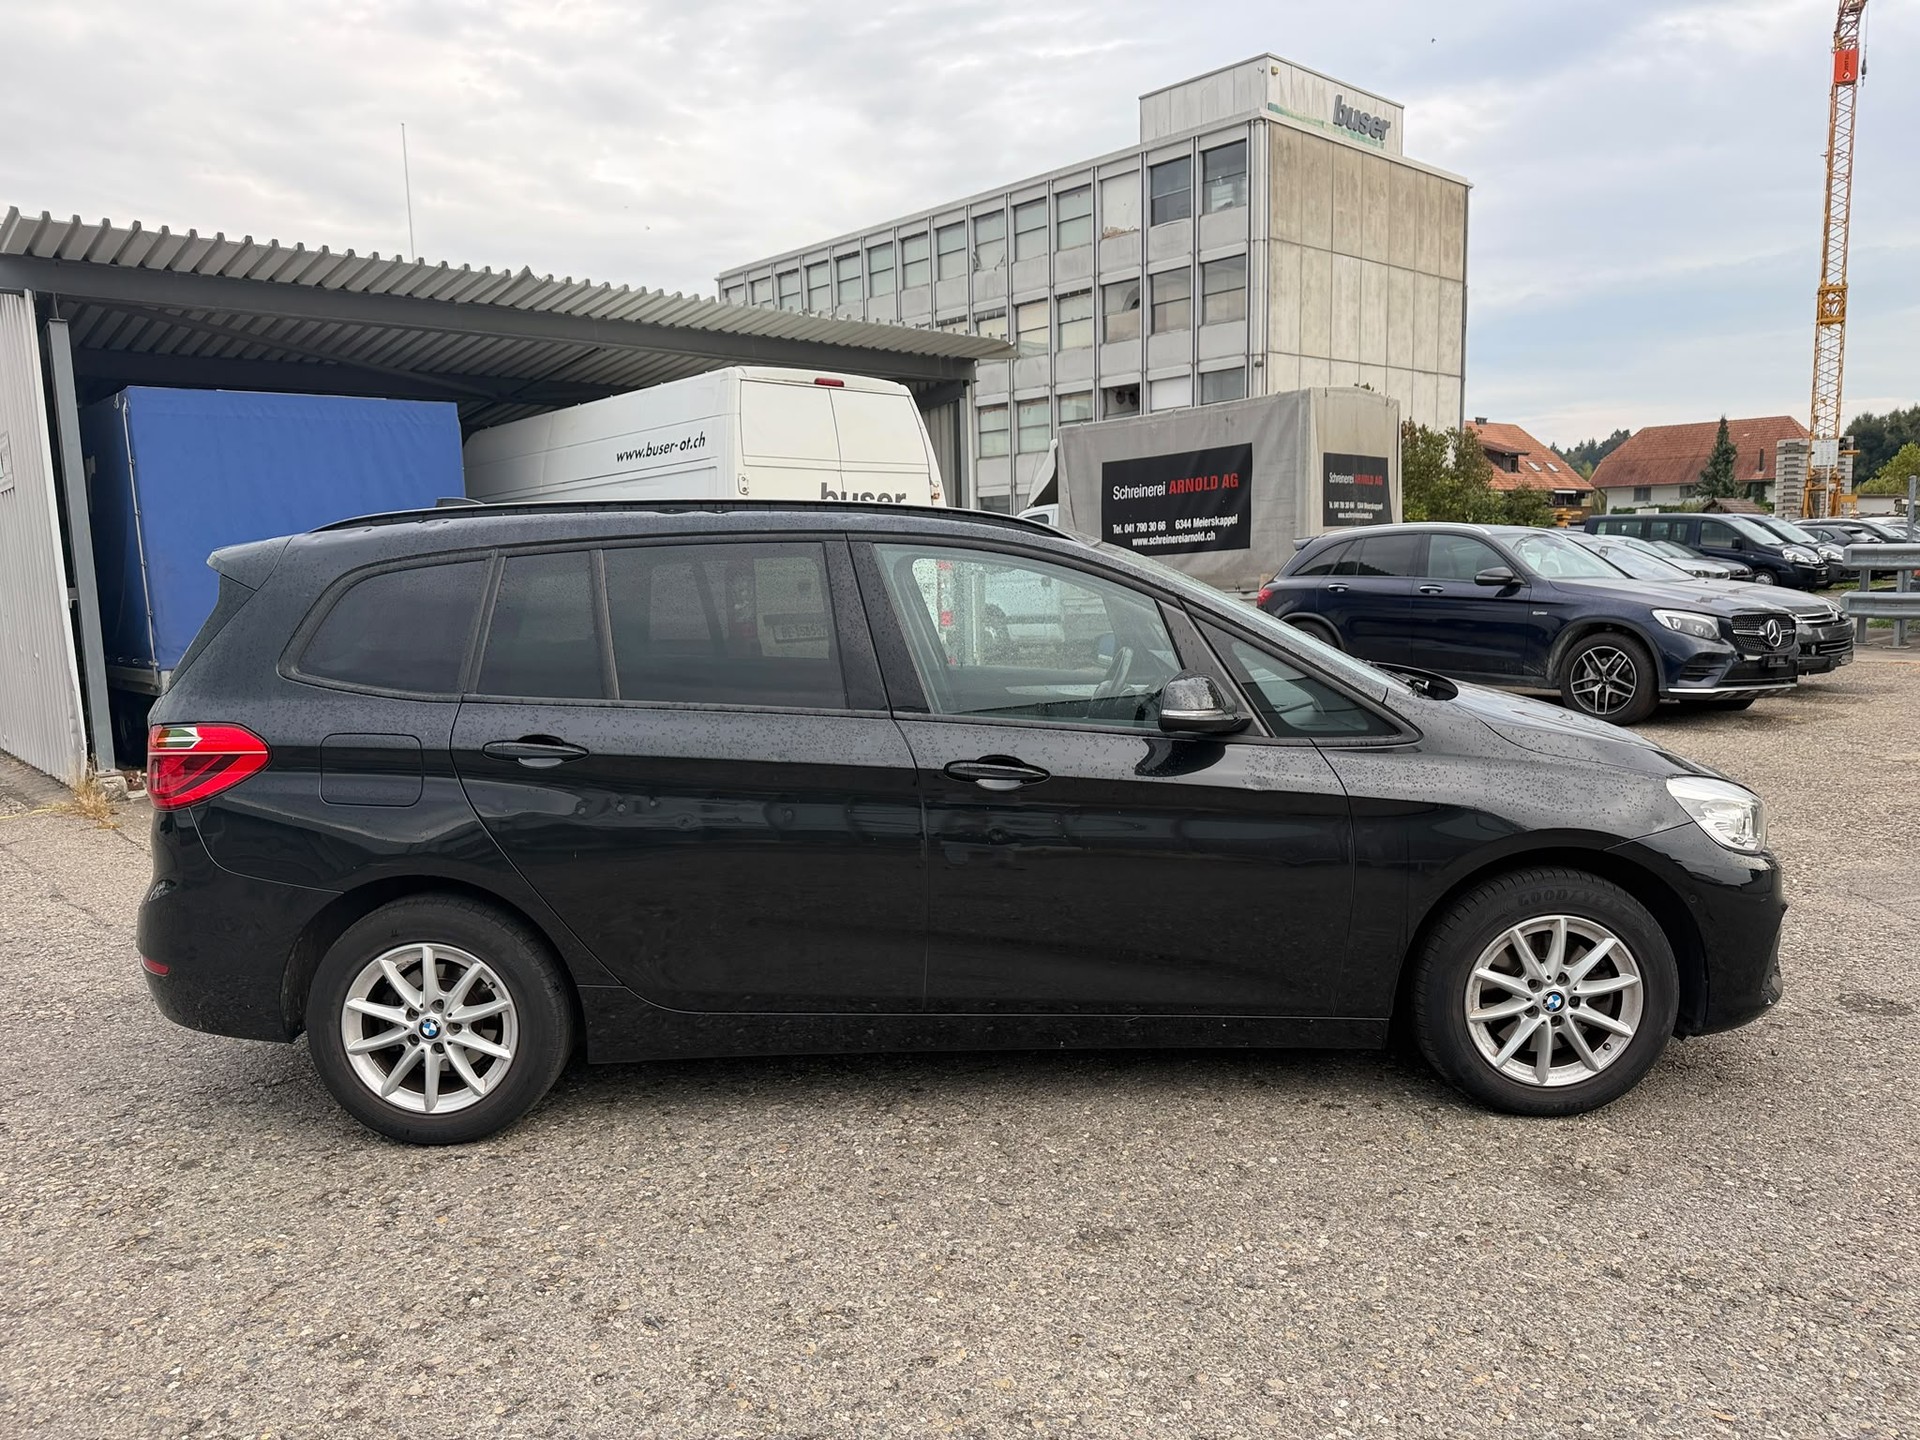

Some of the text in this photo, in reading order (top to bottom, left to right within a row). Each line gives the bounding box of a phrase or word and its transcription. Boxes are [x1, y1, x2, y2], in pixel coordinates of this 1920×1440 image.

[1333, 94, 1391, 141] buser
[616, 431, 706, 463] www.buser-ot.ch
[1113, 473, 1239, 500] Schreinerei ARNOLD AG
[1113, 514, 1238, 534] Tel. 041 790 30 66 6344 Meierskappel
[1132, 531, 1216, 546] www.schreinereiarnold.ch
